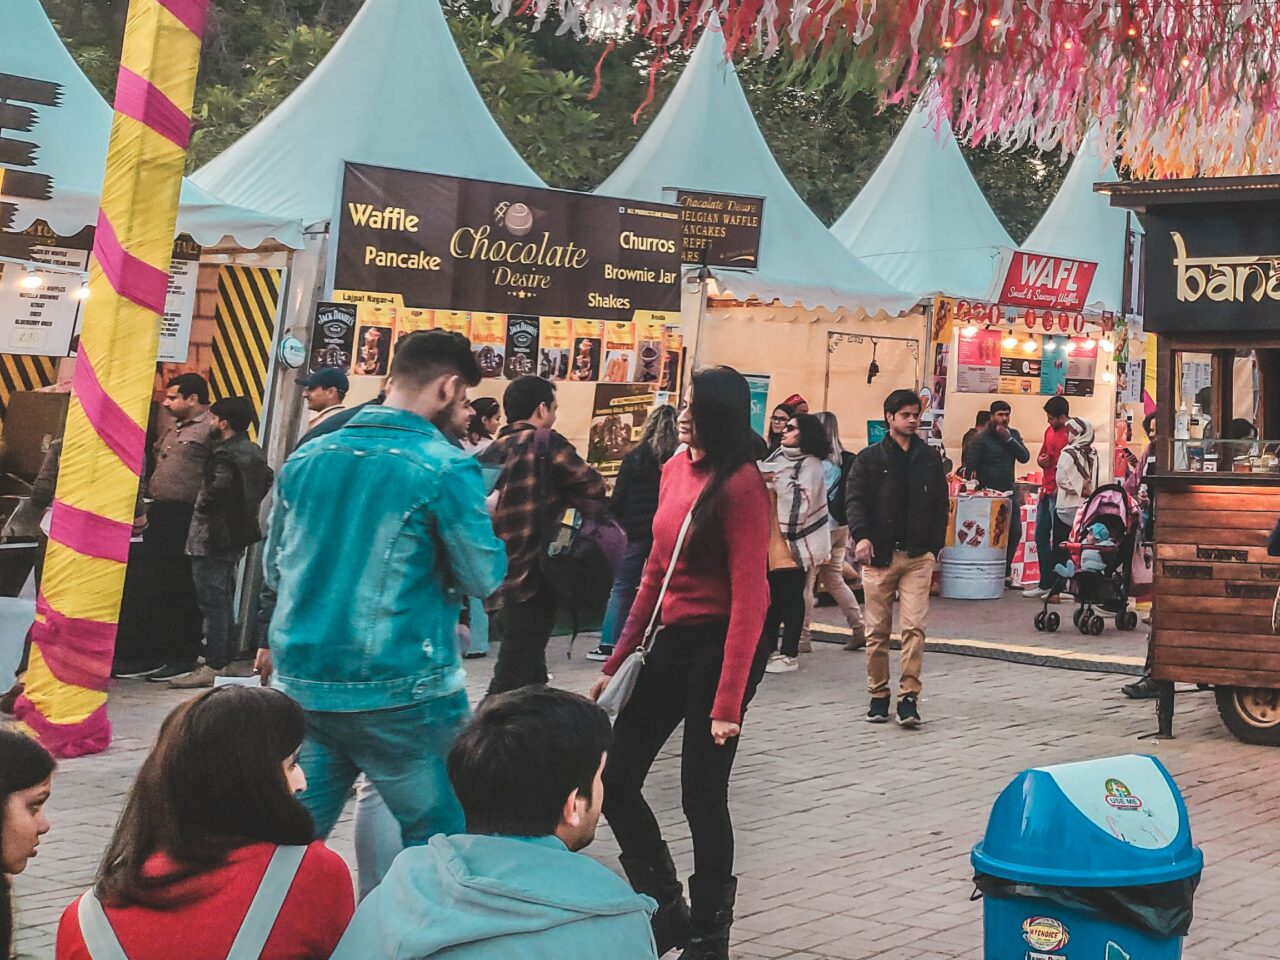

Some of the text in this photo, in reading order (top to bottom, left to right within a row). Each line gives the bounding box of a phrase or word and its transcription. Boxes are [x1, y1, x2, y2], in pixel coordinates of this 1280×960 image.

[348, 202, 420, 233] Waffle
[723, 214, 758, 227] WAFFLE
[681, 224, 726, 238] ANCAKES
[450, 225, 589, 269] Chocolate
[619, 231, 676, 254] Churros
[365, 245, 442, 271] Pancake
[492, 266, 551, 289] Desire
[604, 263, 677, 285] Brownie Jar
[1021, 254, 1079, 291] WAFL
[587, 292, 630, 309] Shakes
[318, 312, 333, 325] JACK
[1110, 797, 1126, 805] USE
